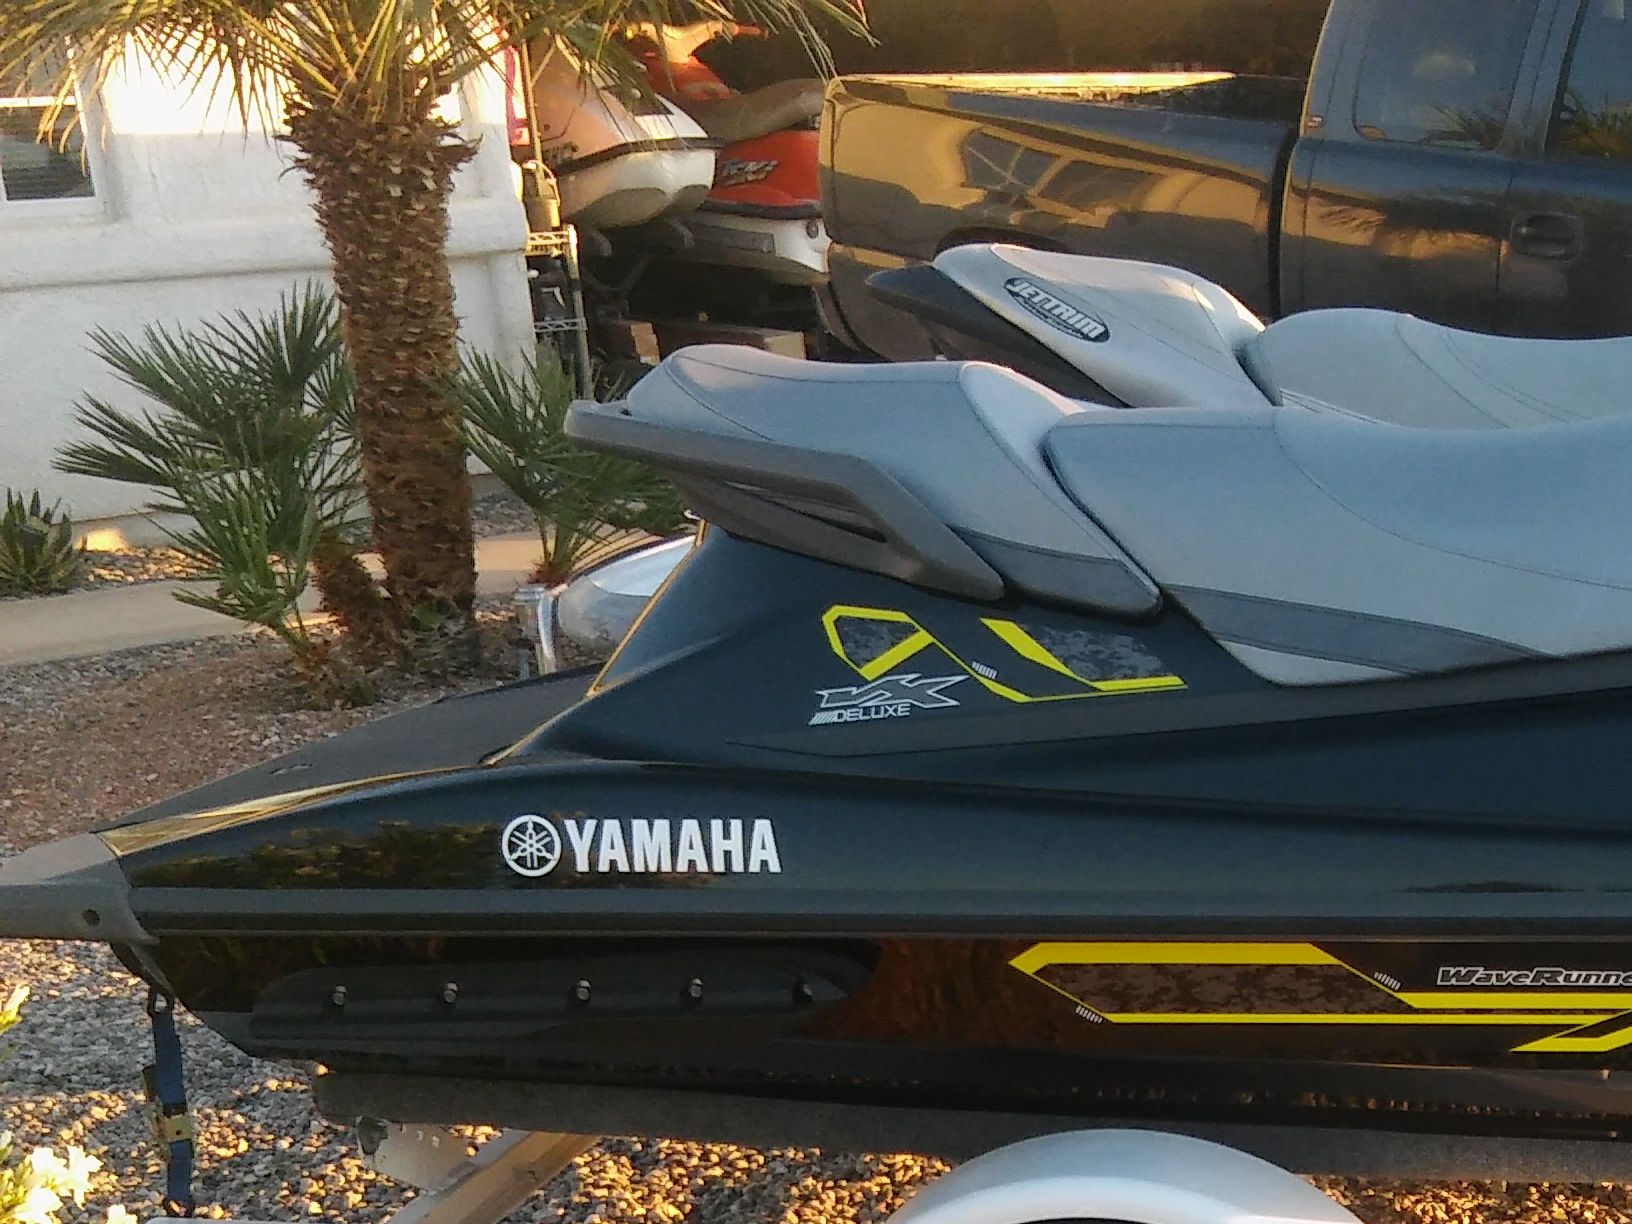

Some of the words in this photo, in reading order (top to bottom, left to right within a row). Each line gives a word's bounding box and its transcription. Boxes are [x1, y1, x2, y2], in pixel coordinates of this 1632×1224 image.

[1005, 281, 1106, 339] JETTRIM
[833, 703, 911, 722] DELUXE
[563, 818, 782, 873] YAMAHA
